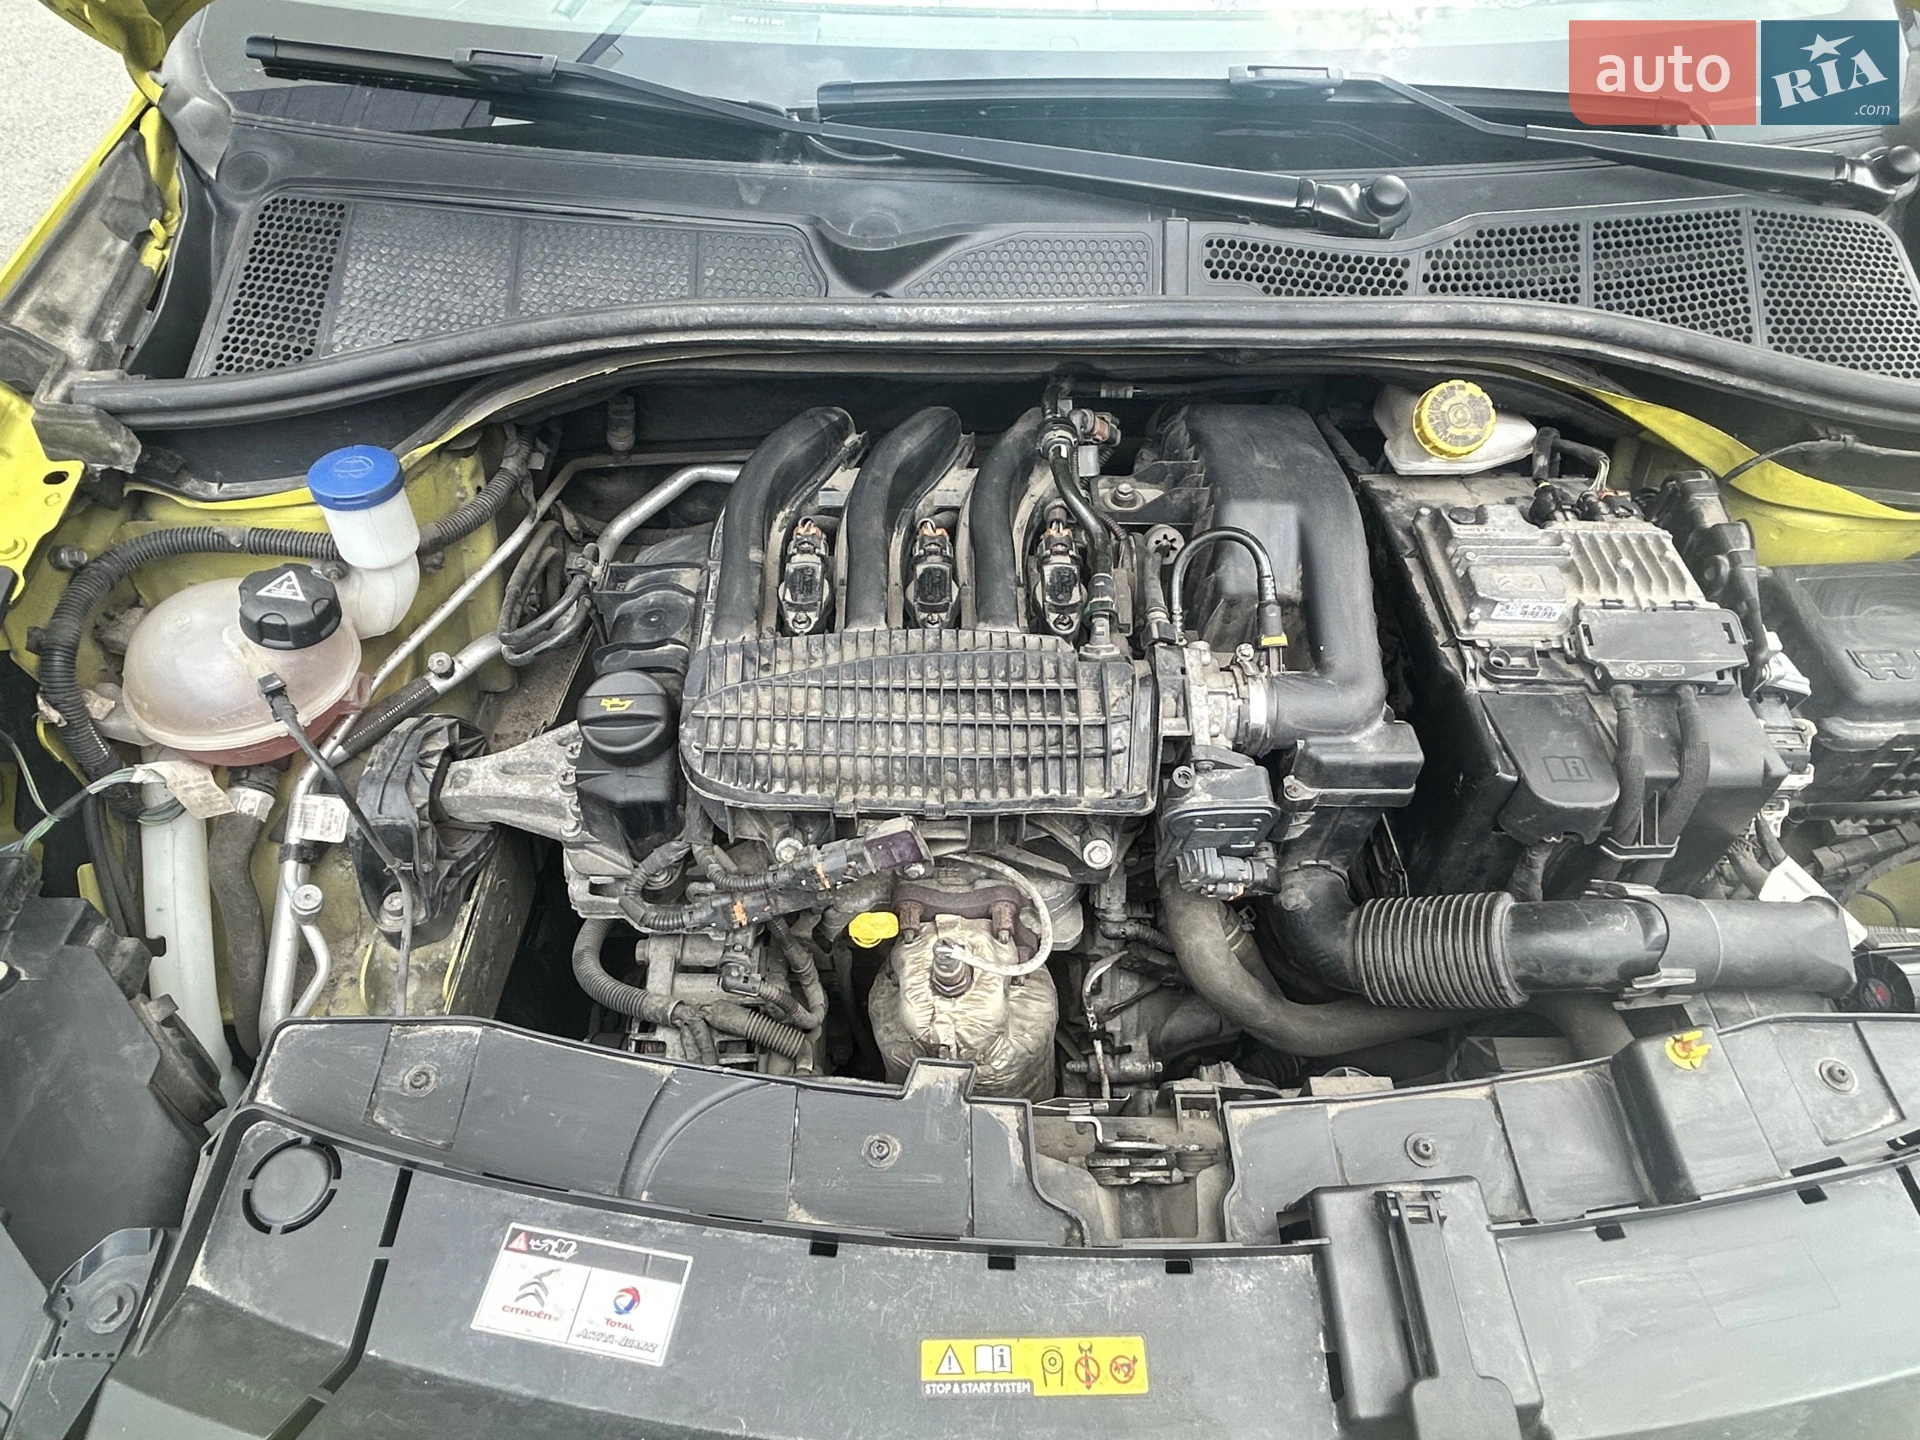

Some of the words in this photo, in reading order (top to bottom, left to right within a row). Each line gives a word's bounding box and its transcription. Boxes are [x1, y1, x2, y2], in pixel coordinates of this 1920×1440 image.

[925, 1383, 951, 1395] STOP
[952, 1382, 960, 1394] &
[961, 1382, 992, 1394] START
[993, 1381, 1031, 1394] SYSTEM
